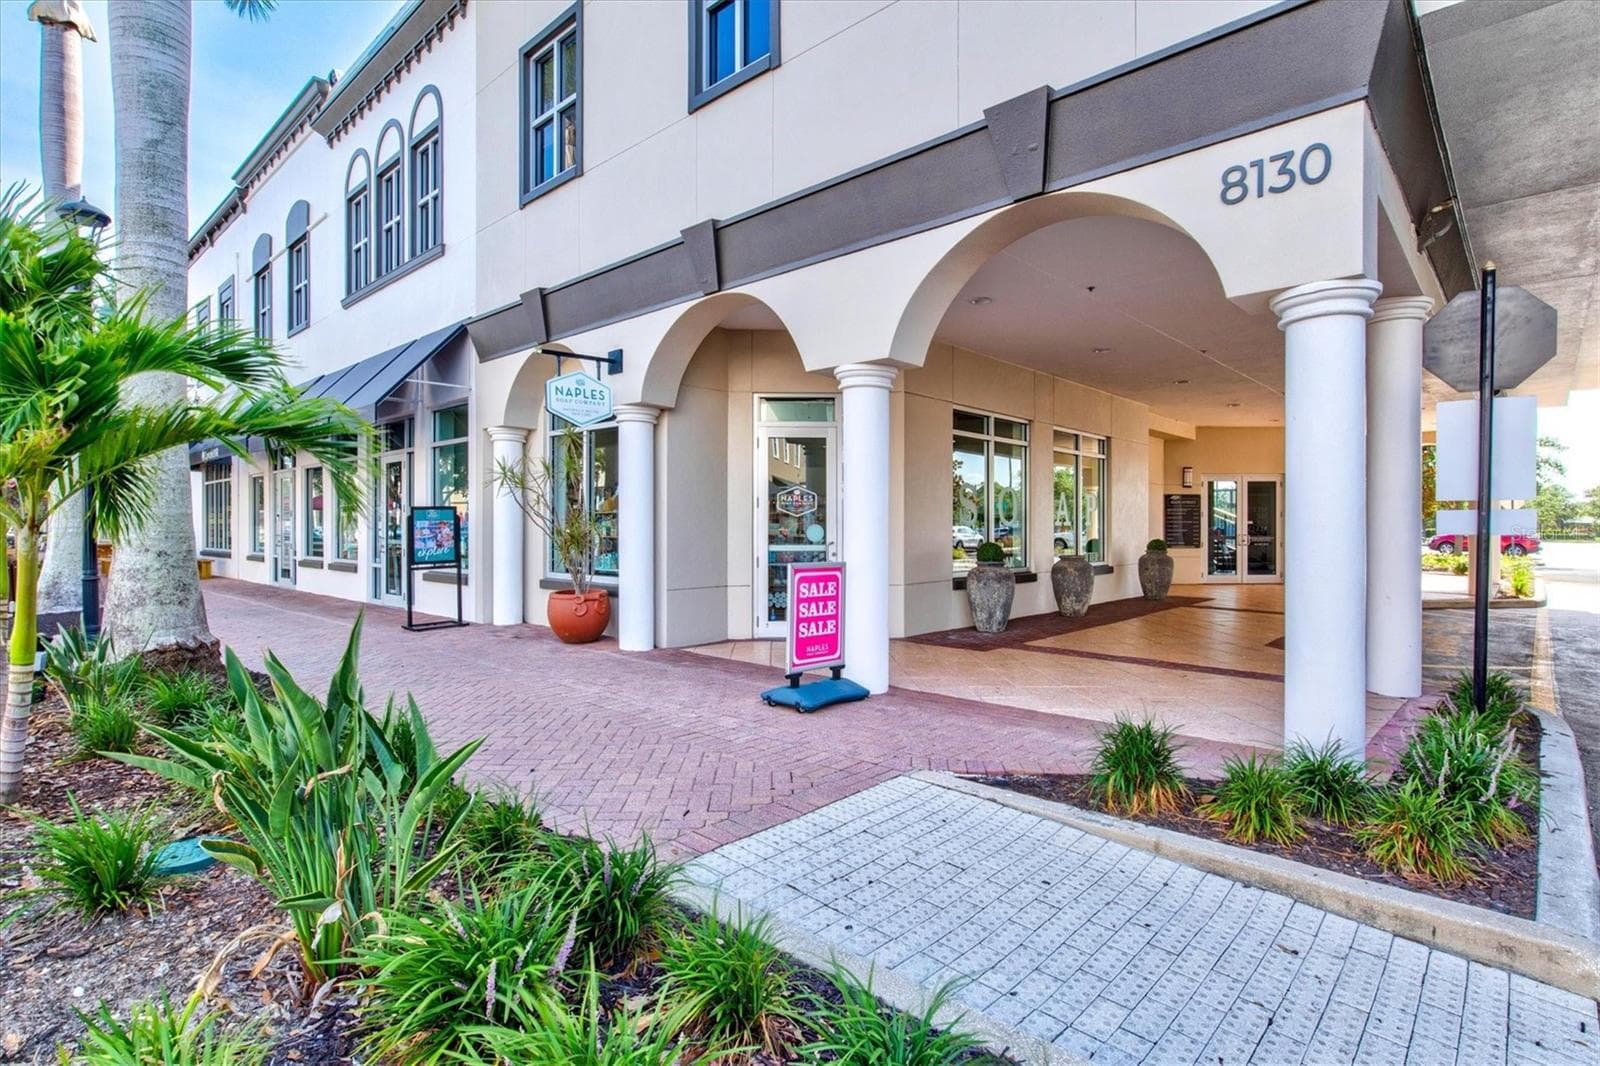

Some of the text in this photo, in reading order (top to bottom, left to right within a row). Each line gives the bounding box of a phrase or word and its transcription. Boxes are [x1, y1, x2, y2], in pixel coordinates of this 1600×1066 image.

[1220, 143, 1332, 205] 8130
[555, 385, 606, 401] NAPLES
[800, 582, 837, 598] SALE
[799, 601, 837, 618] SALE
[799, 620, 837, 638] SALE
